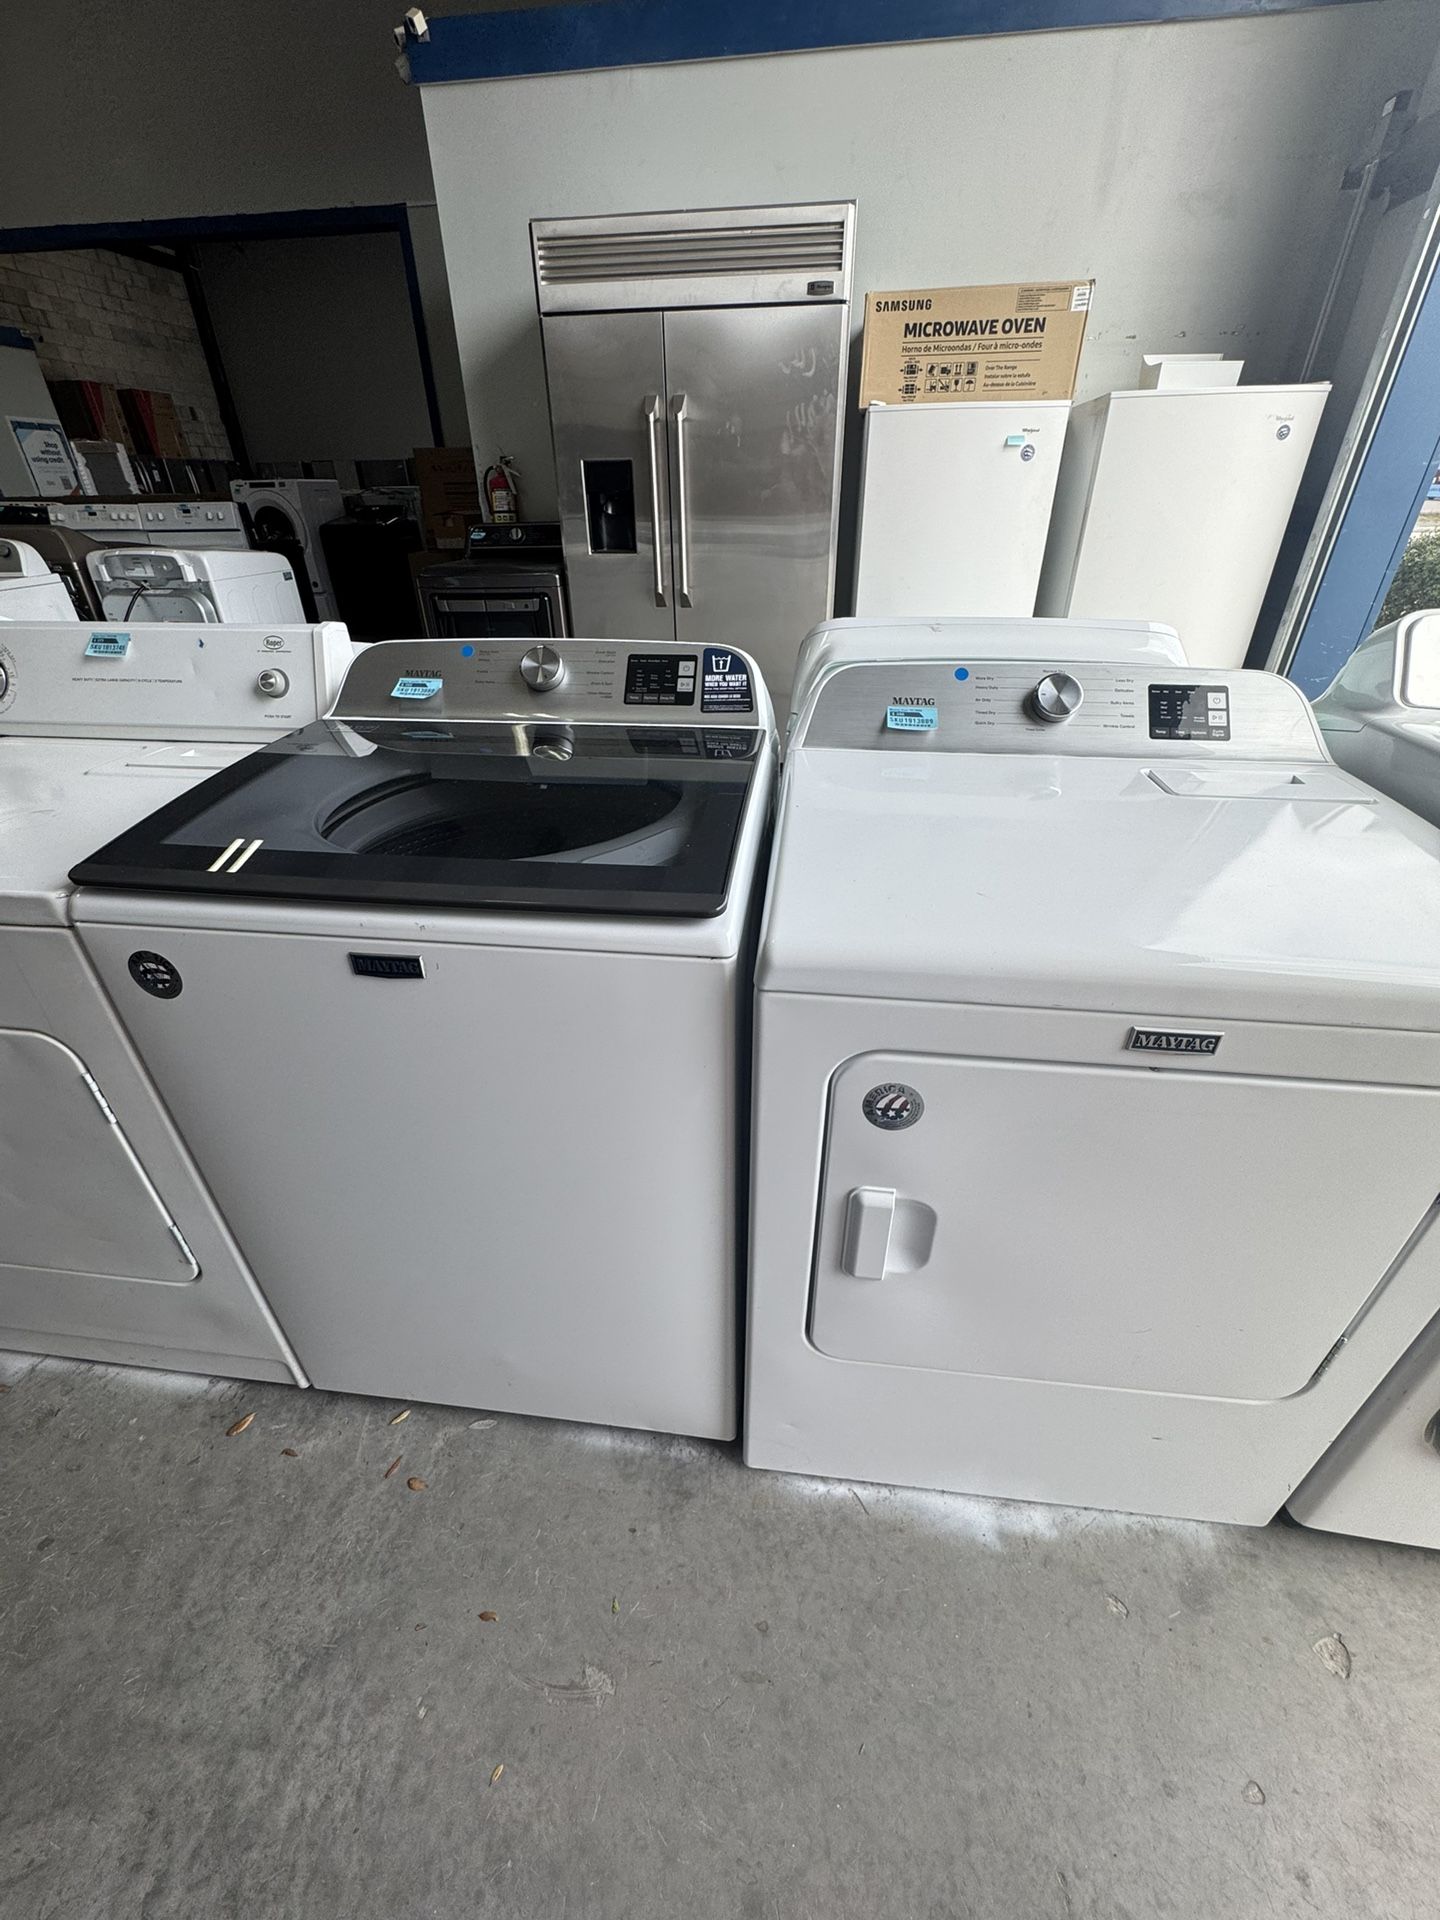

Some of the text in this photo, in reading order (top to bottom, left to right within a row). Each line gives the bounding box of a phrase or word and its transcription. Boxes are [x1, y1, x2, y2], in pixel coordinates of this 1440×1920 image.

[875, 298, 933, 312] SAMSUNG
[903, 317, 1047, 338] MICROWAVE OVEN
[901, 340, 1043, 354] Horno de Microondas / Four à micro-ondes
[43, 441, 59, 449] Shop
[31, 456, 49, 464] using
[406, 669, 442, 677] MAYTAG
[705, 674, 724, 682] MORE
[892, 696, 935, 706] MAYTAG
[356, 958, 418, 974] MAYTAG
[1135, 1034, 1216, 1051] MAYTAG
[865, 1085, 905, 1116] AMERICA
